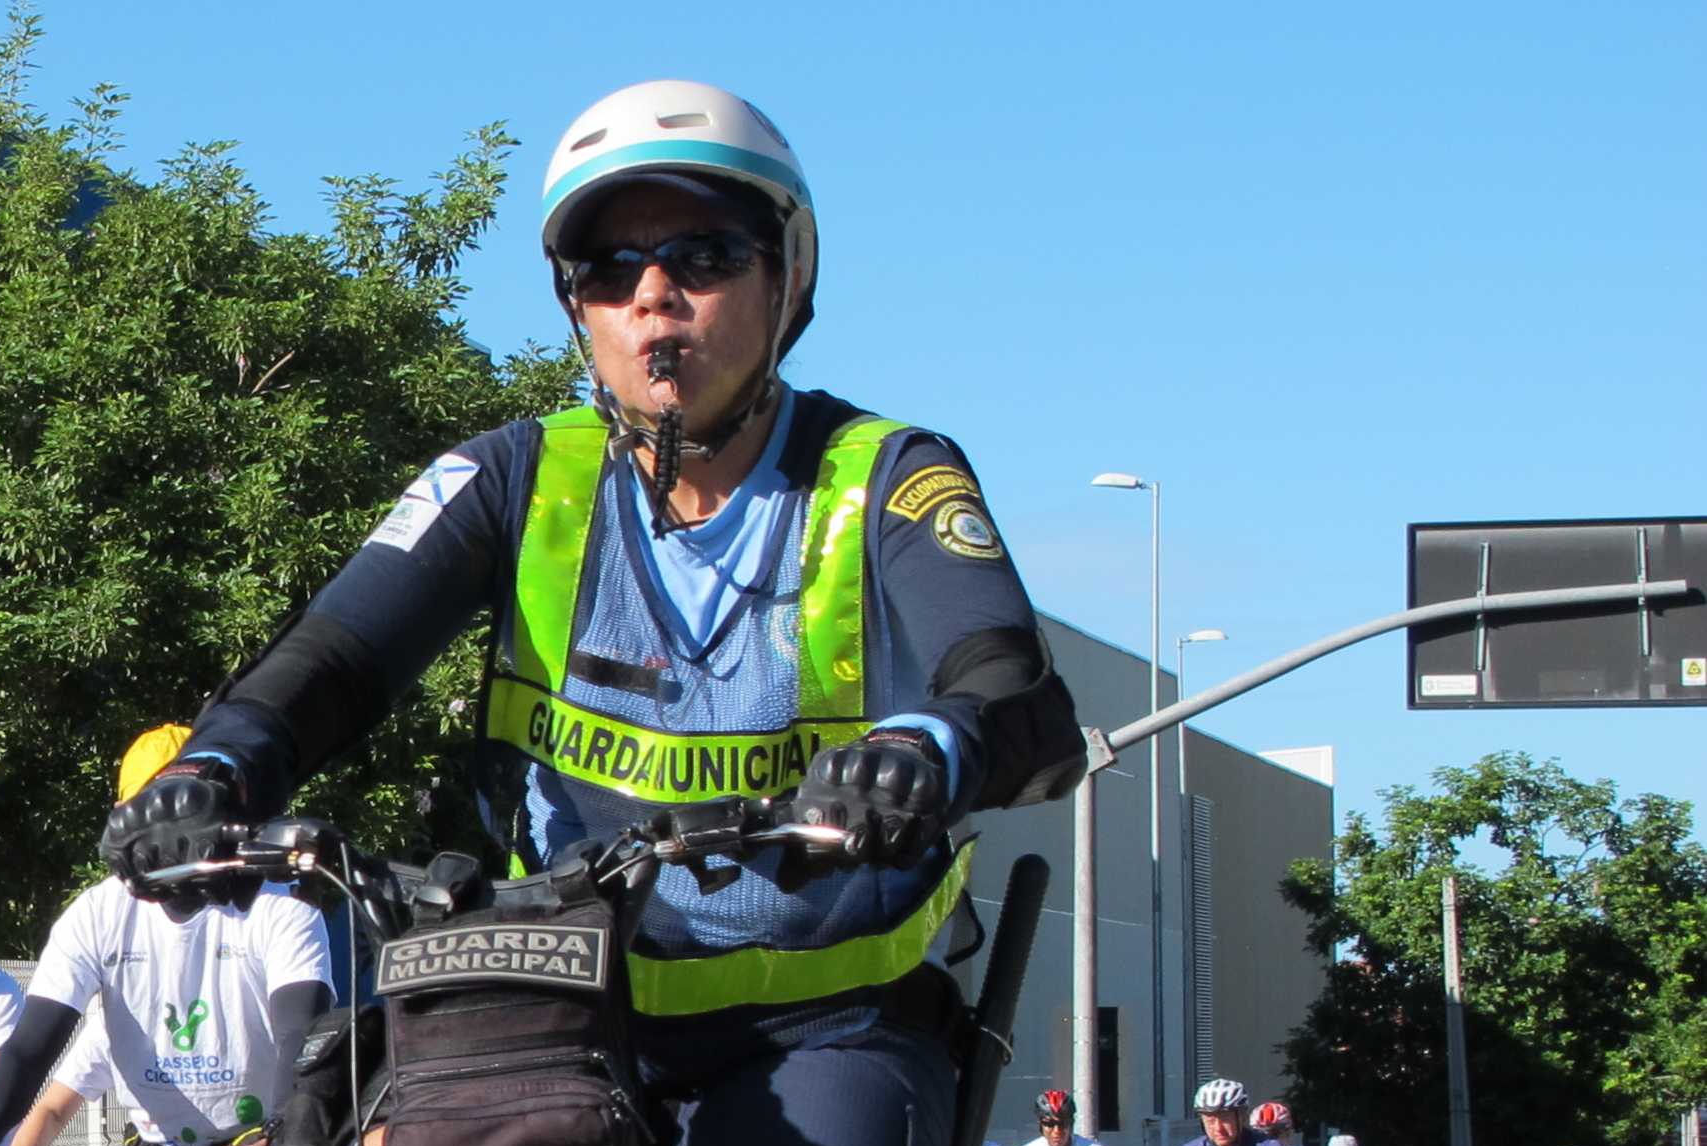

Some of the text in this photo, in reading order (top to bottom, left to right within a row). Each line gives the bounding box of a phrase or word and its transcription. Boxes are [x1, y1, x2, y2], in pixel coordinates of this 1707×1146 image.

[528, 701, 656, 787] GUARDA
[392, 932, 591, 961] GUARDA
[389, 952, 591, 980] MUNICIPAL
[155, 1055, 219, 1069] PASSEIO
